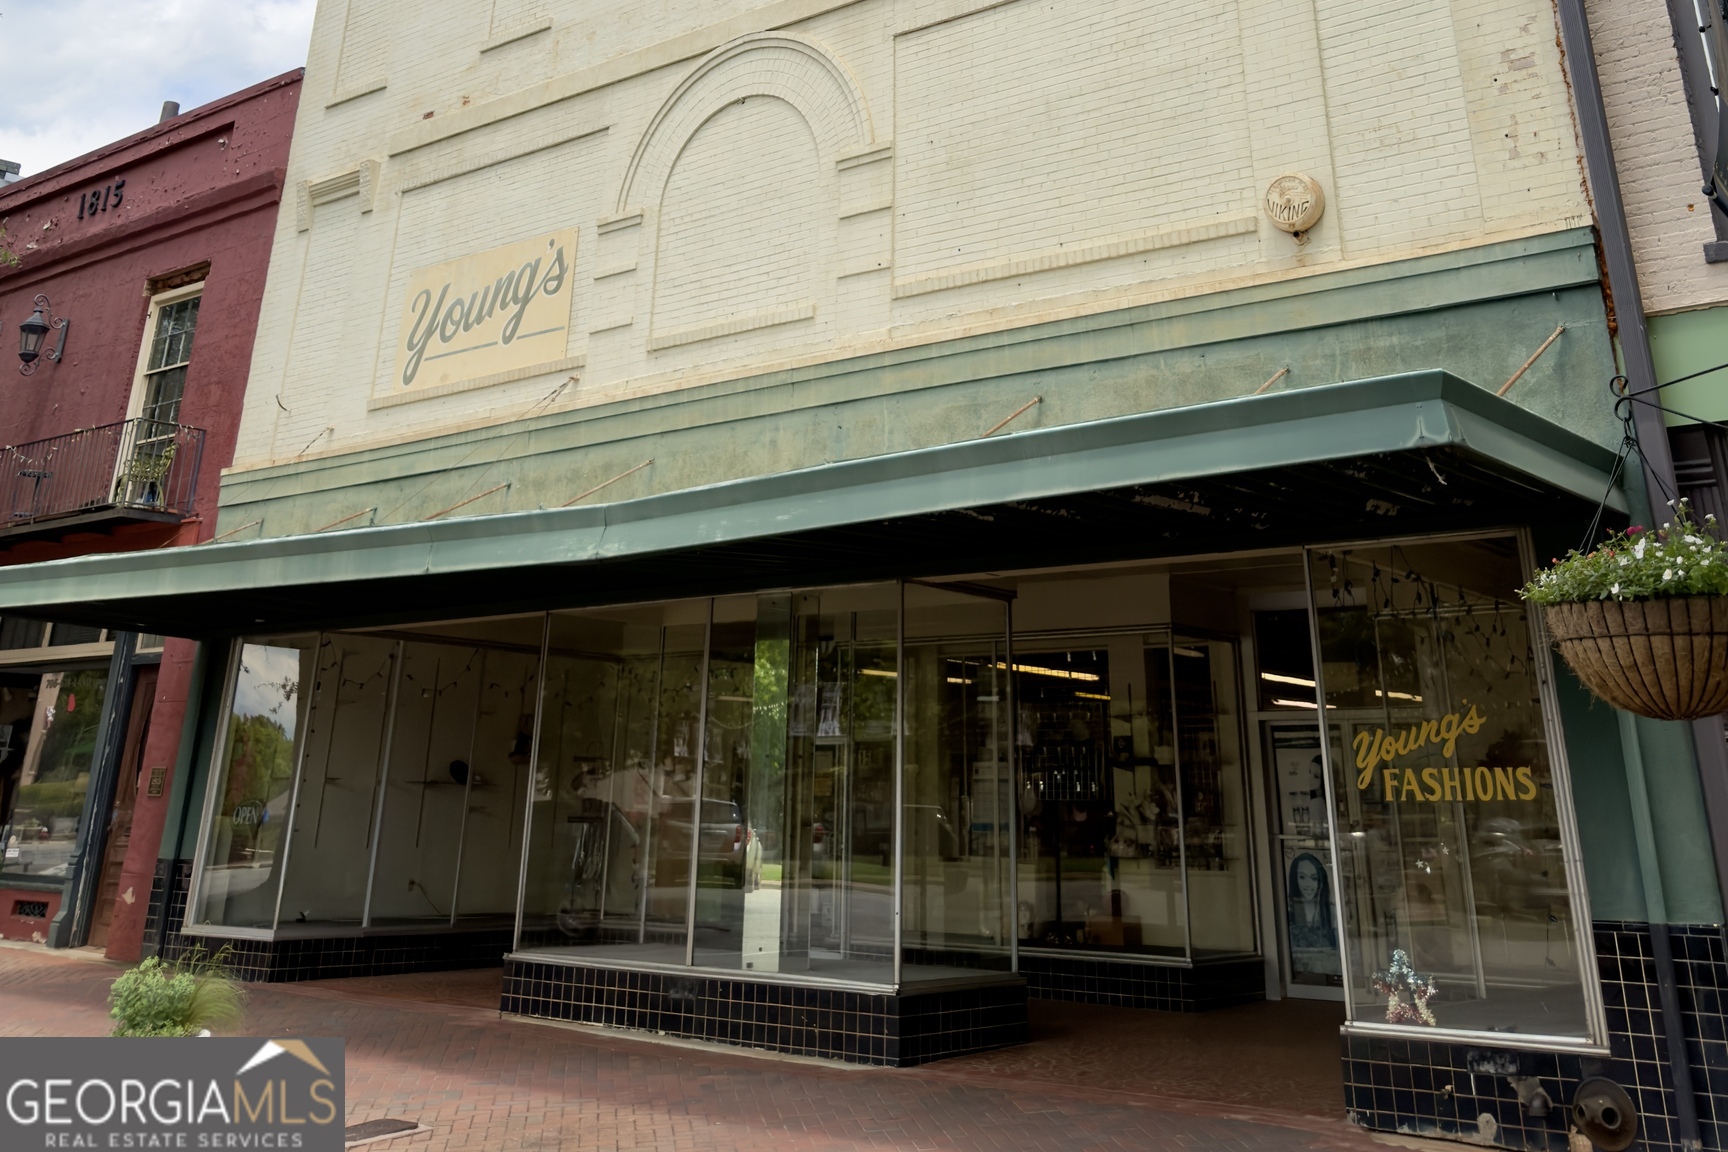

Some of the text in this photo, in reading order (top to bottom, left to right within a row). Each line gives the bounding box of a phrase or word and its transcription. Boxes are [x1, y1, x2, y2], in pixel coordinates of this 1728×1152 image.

[77, 179, 126, 220] 1815
[1267, 198, 1310, 222] VIKING
[402, 238, 569, 386] Young's
[1353, 699, 1487, 790] Young's
[1383, 765, 1537, 802] FASHIONS
[232, 806, 258, 825] OPEN
